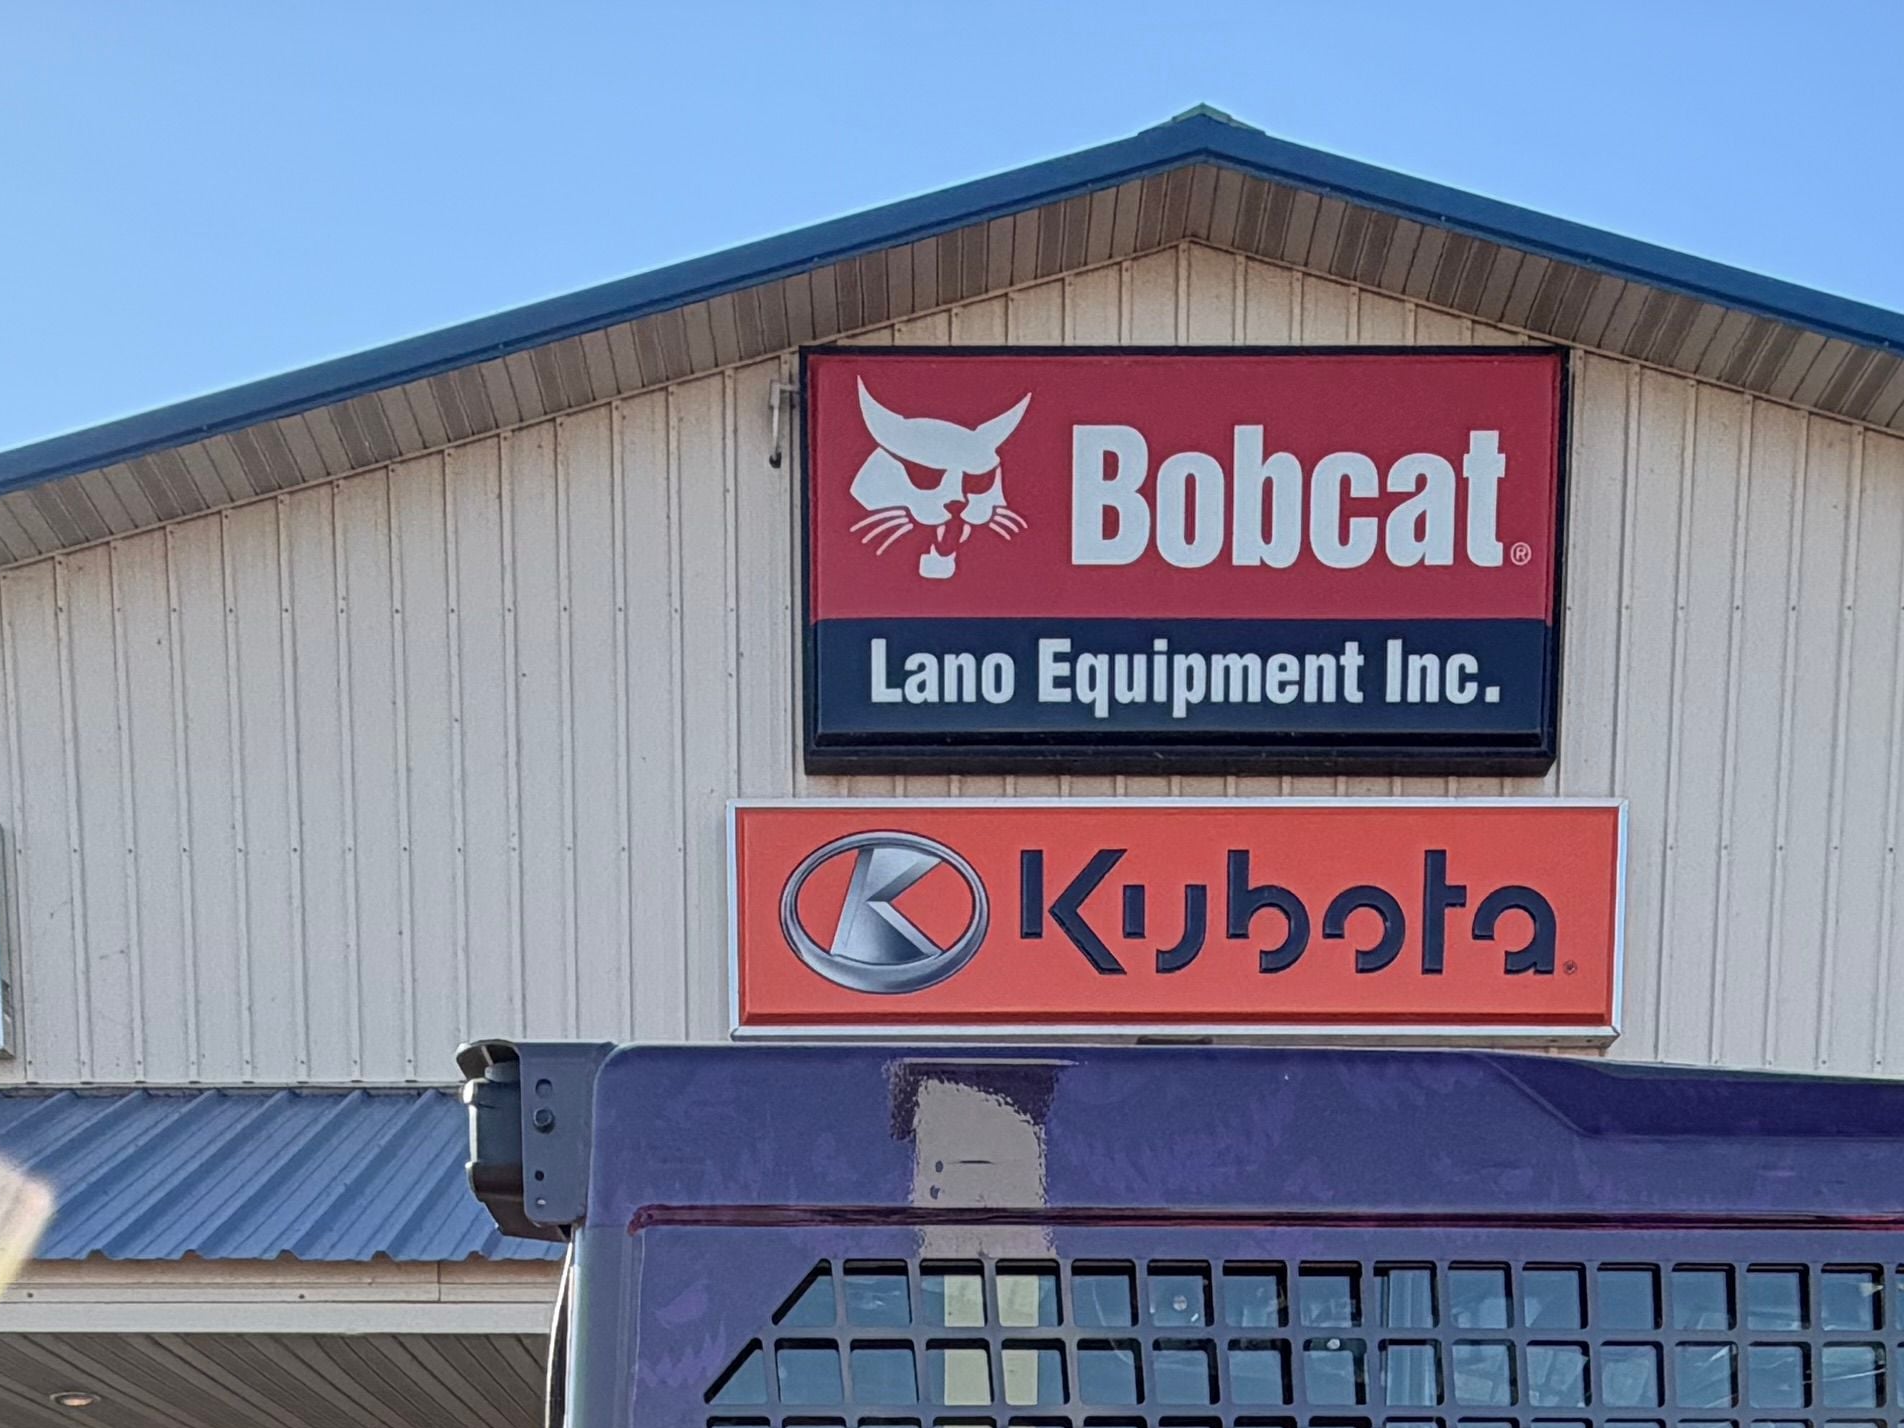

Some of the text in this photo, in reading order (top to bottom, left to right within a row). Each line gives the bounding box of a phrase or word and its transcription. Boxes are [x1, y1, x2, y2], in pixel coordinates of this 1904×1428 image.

[1071, 424, 1506, 568] Bobcat
[870, 637, 1501, 718] Lano Equipment Inc.
[1020, 848, 1557, 976] Kubota
